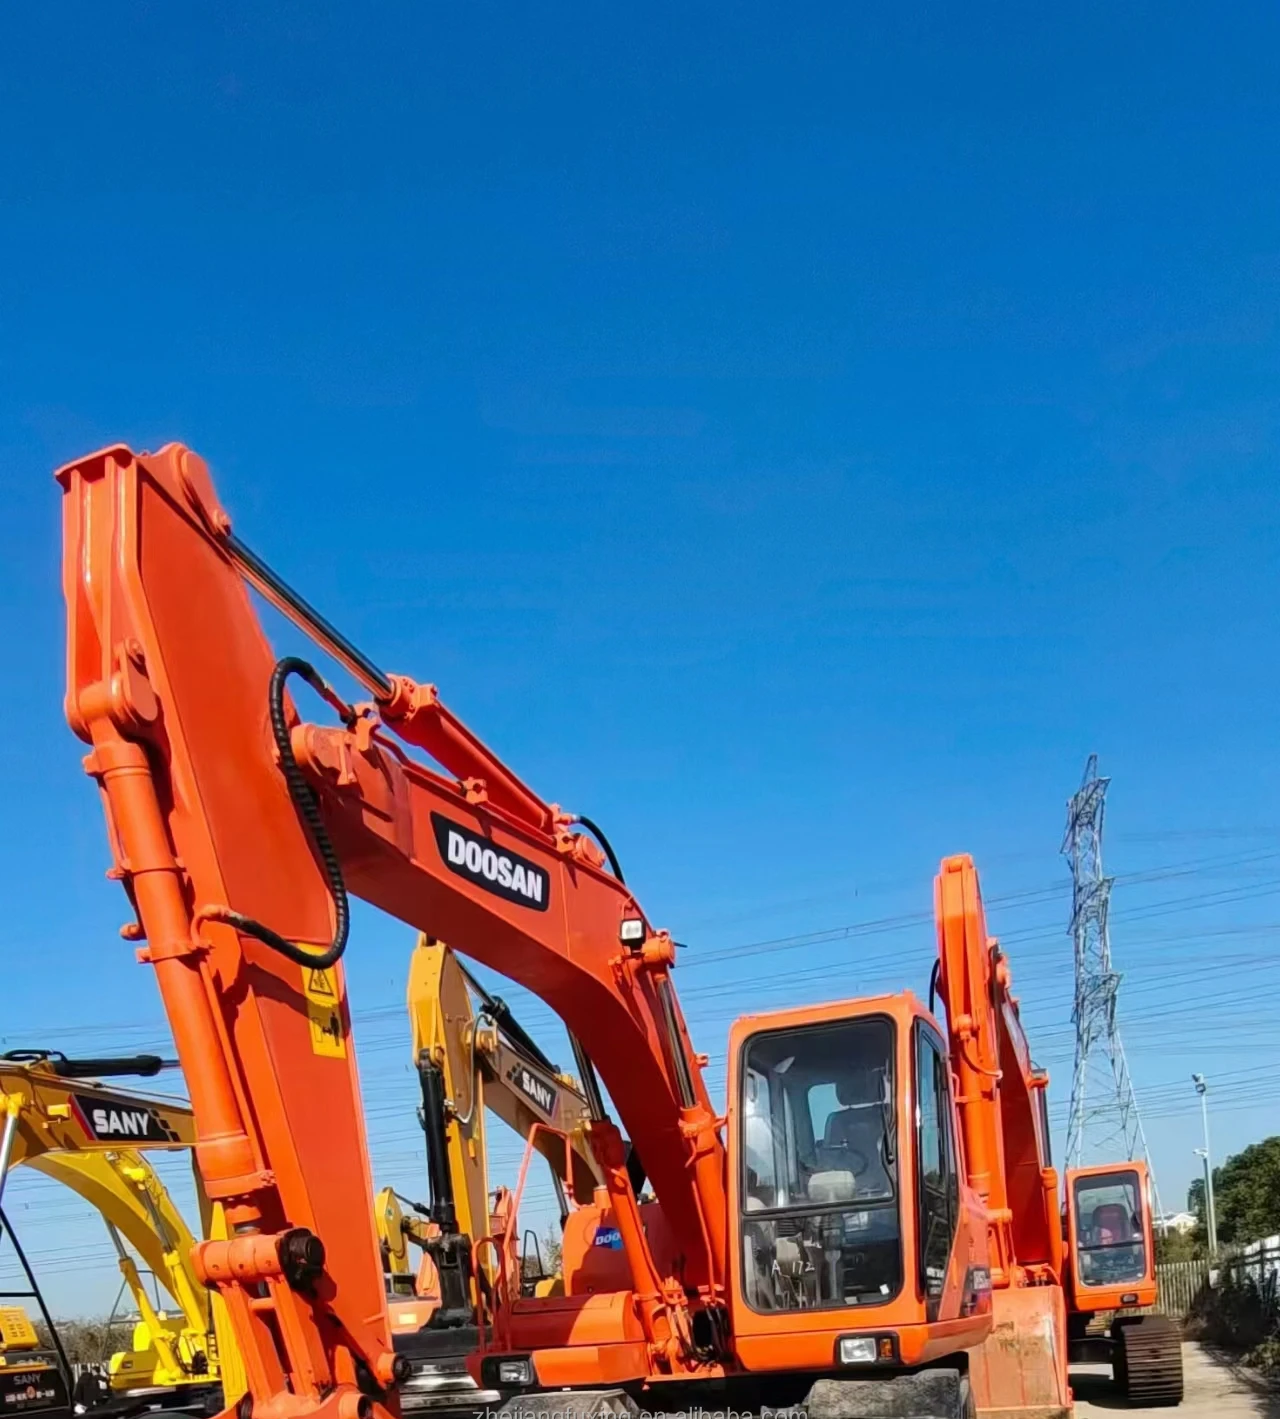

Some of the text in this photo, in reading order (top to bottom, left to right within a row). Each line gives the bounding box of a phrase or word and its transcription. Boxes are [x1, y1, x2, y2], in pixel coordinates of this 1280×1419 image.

[447, 830, 543, 903] DOOSAN
[522, 1070, 551, 1110] SANY
[92, 1109, 149, 1136] SANY
[13, 1373, 41, 1385] SANY
